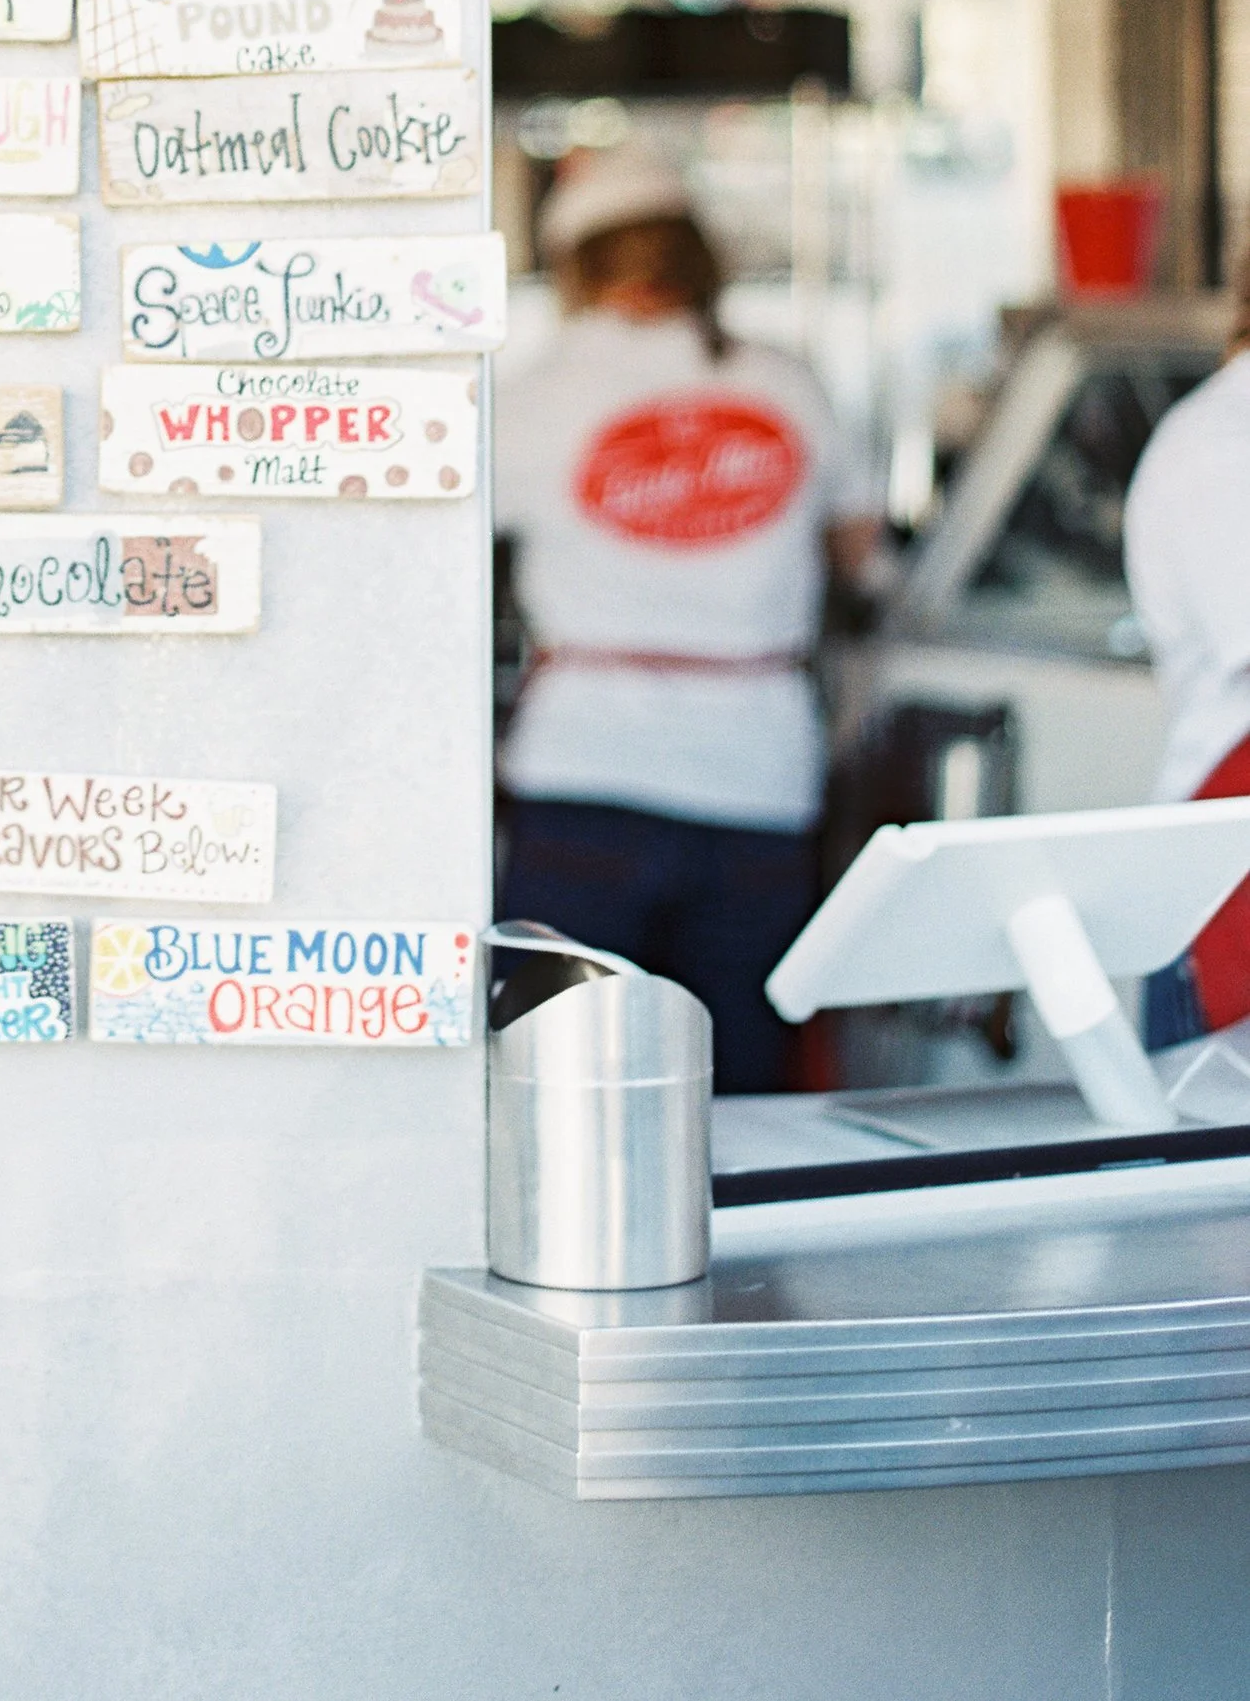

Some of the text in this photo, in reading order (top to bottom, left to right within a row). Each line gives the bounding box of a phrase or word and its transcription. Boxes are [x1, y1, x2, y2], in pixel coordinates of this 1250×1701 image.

[133, 91, 468, 180] Oatmeal Cookie
[130, 251, 391, 362] Space Junkie
[215, 368, 361, 399] Chocolate
[157, 403, 395, 445] WHOPPER
[244, 454, 329, 487] Malt
[40, 775, 189, 823] Week
[133, 824, 264, 877] Below:
[145, 924, 429, 983] BLUE MOON
